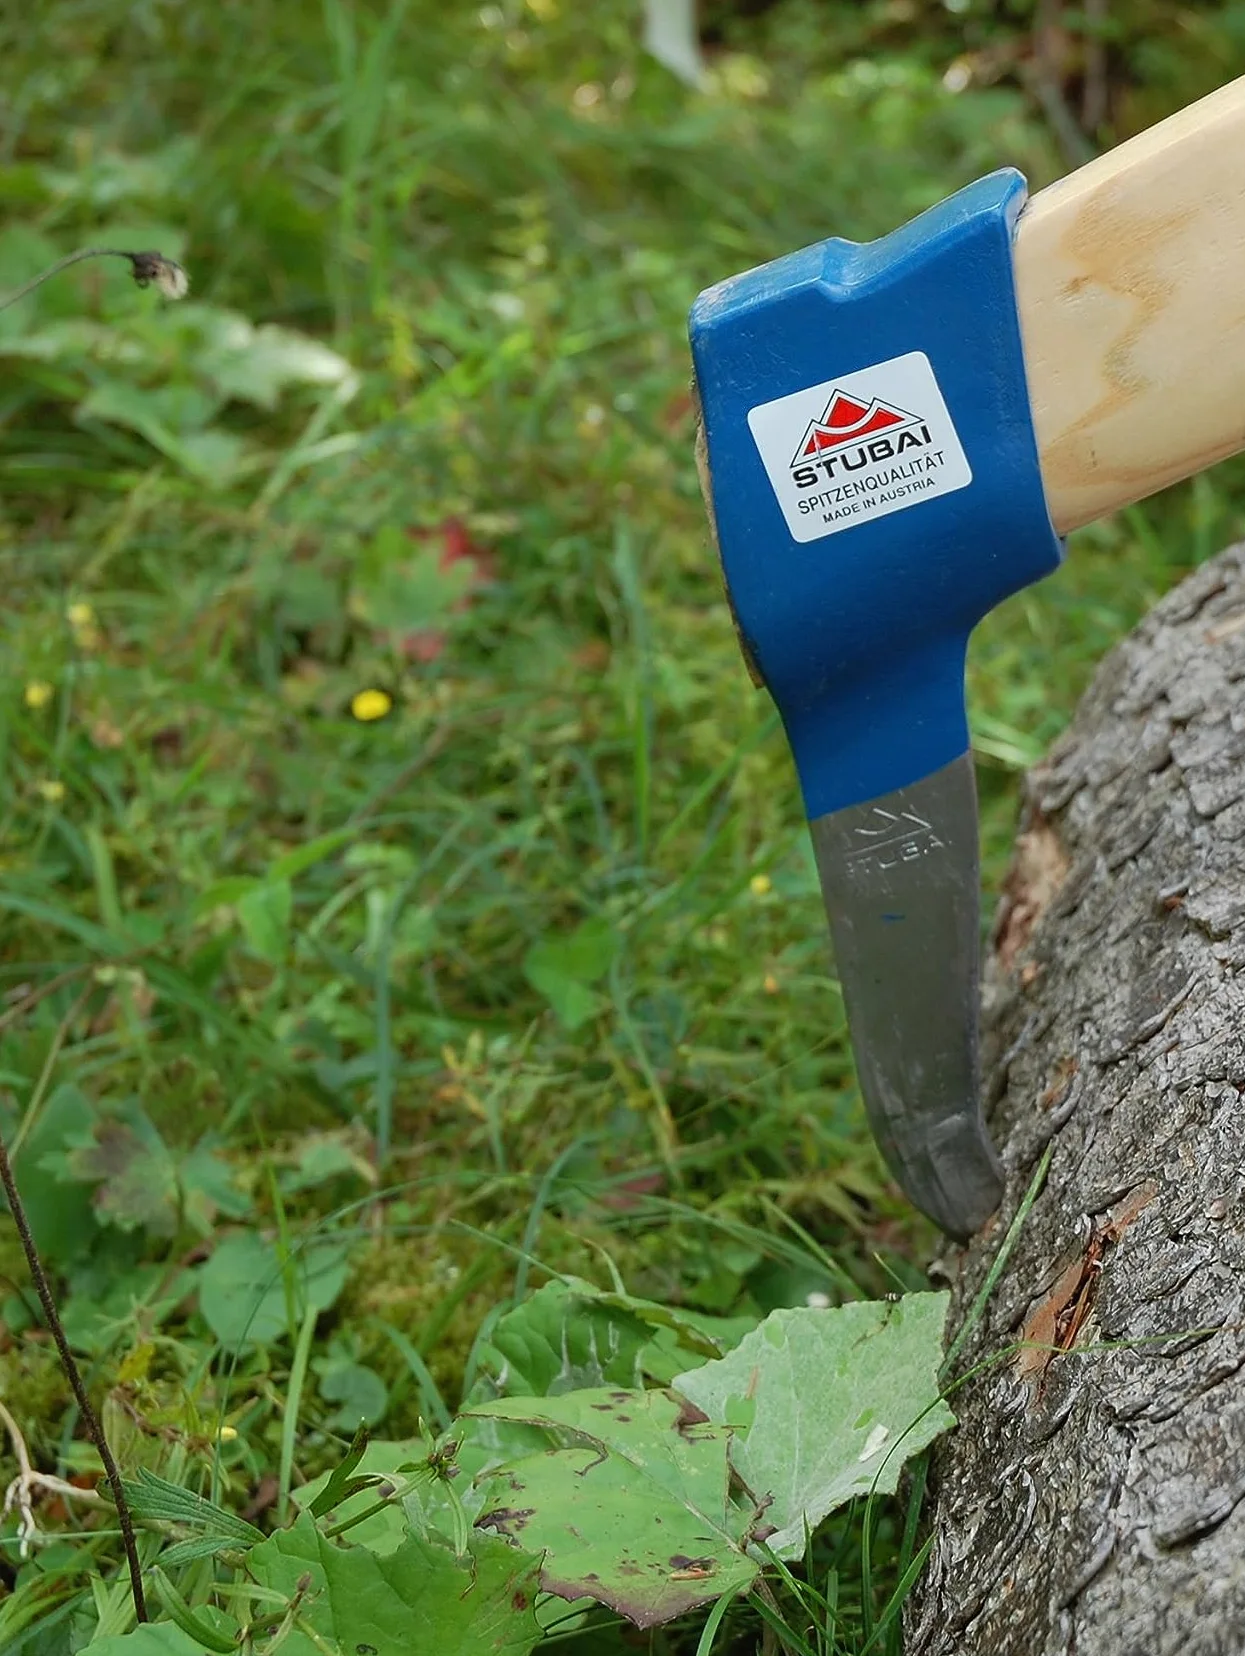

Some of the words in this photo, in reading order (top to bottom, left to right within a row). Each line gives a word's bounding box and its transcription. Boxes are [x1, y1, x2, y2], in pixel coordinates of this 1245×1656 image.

[792, 425, 932, 488] STUBAI
[798, 451, 944, 514] SPITZENQUALITÄT
[822, 504, 860, 524] MADE
[862, 496, 877, 509] IN
[879, 477, 935, 504] AUSTRIA
